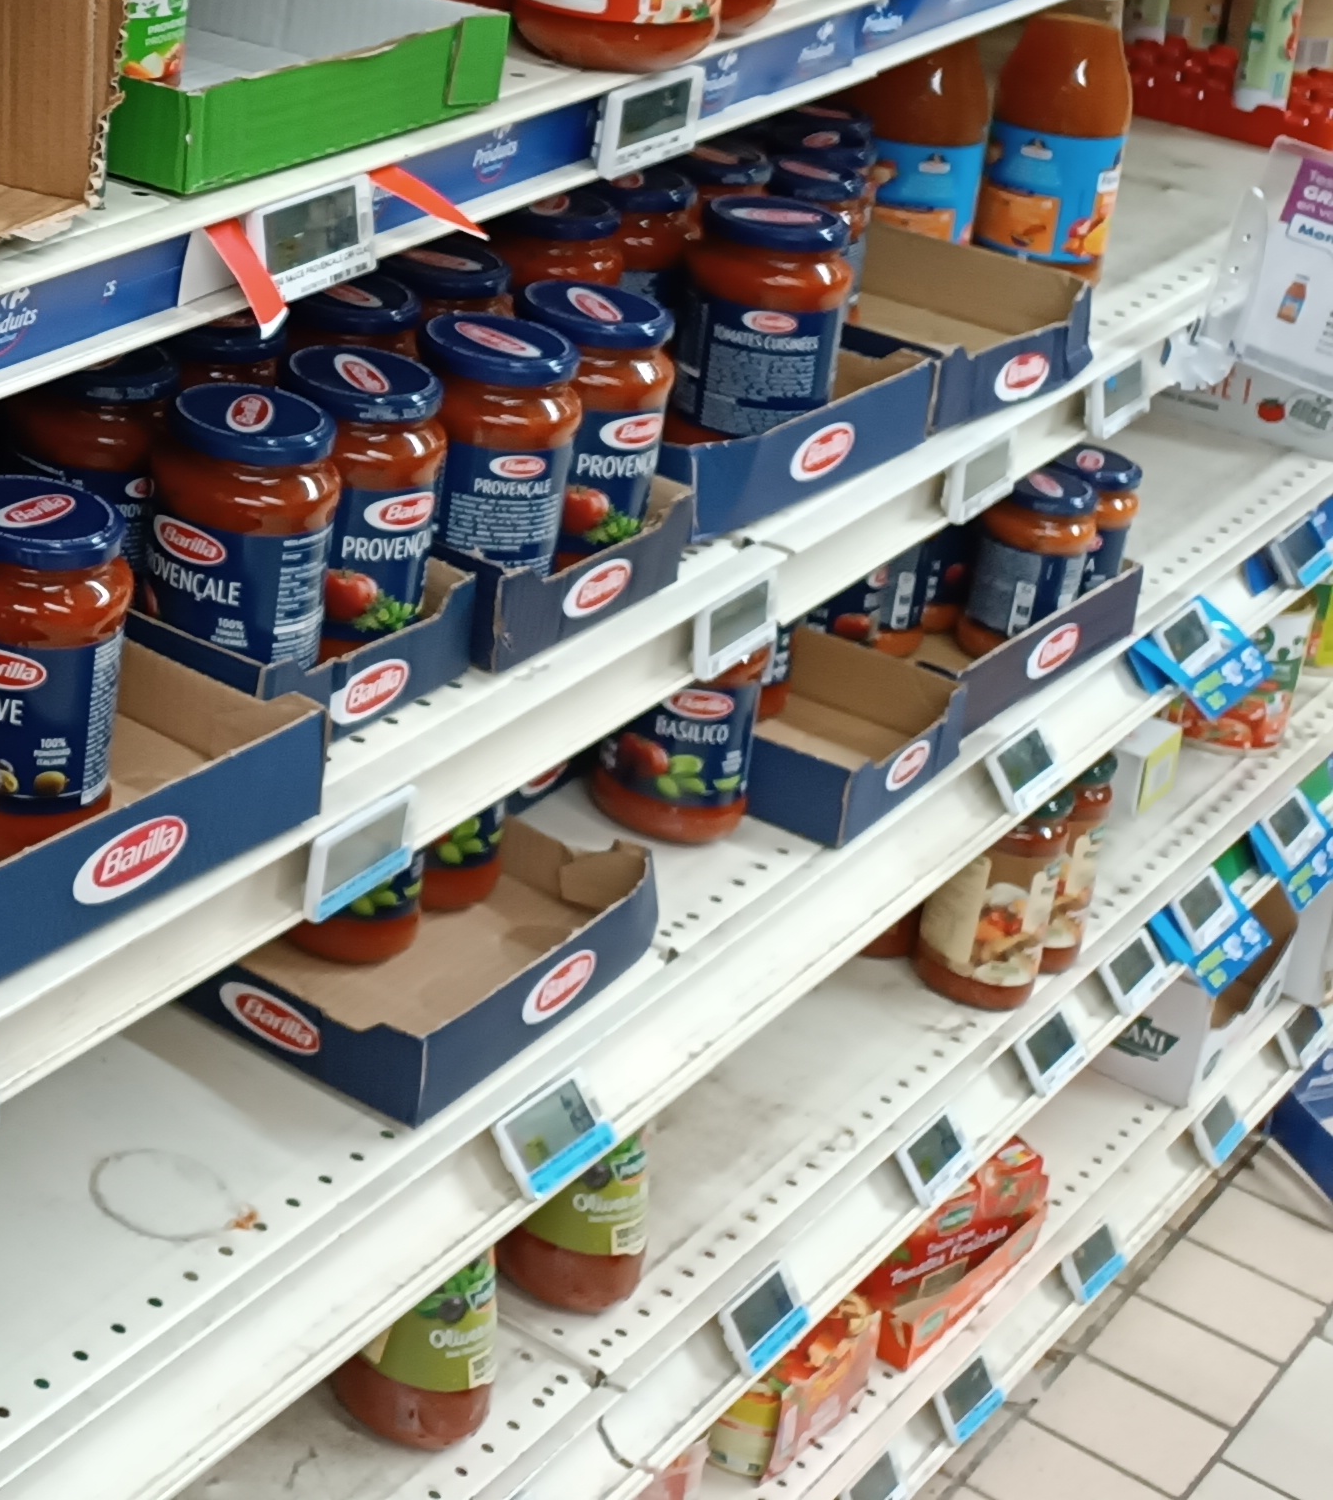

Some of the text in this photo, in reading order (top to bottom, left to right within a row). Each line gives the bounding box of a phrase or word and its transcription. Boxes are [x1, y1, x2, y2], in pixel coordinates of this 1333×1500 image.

[473, 475, 552, 498] PROVENÇALE
[8, 495, 73, 525] Barilla
[161, 524, 220, 561] Barilla
[146, 554, 242, 608] OVENÇALE
[348, 668, 408, 713] Barilla
[654, 714, 729, 746] BASILICO
[99, 823, 180, 882] Barilla
[241, 995, 313, 1049] Barilla
